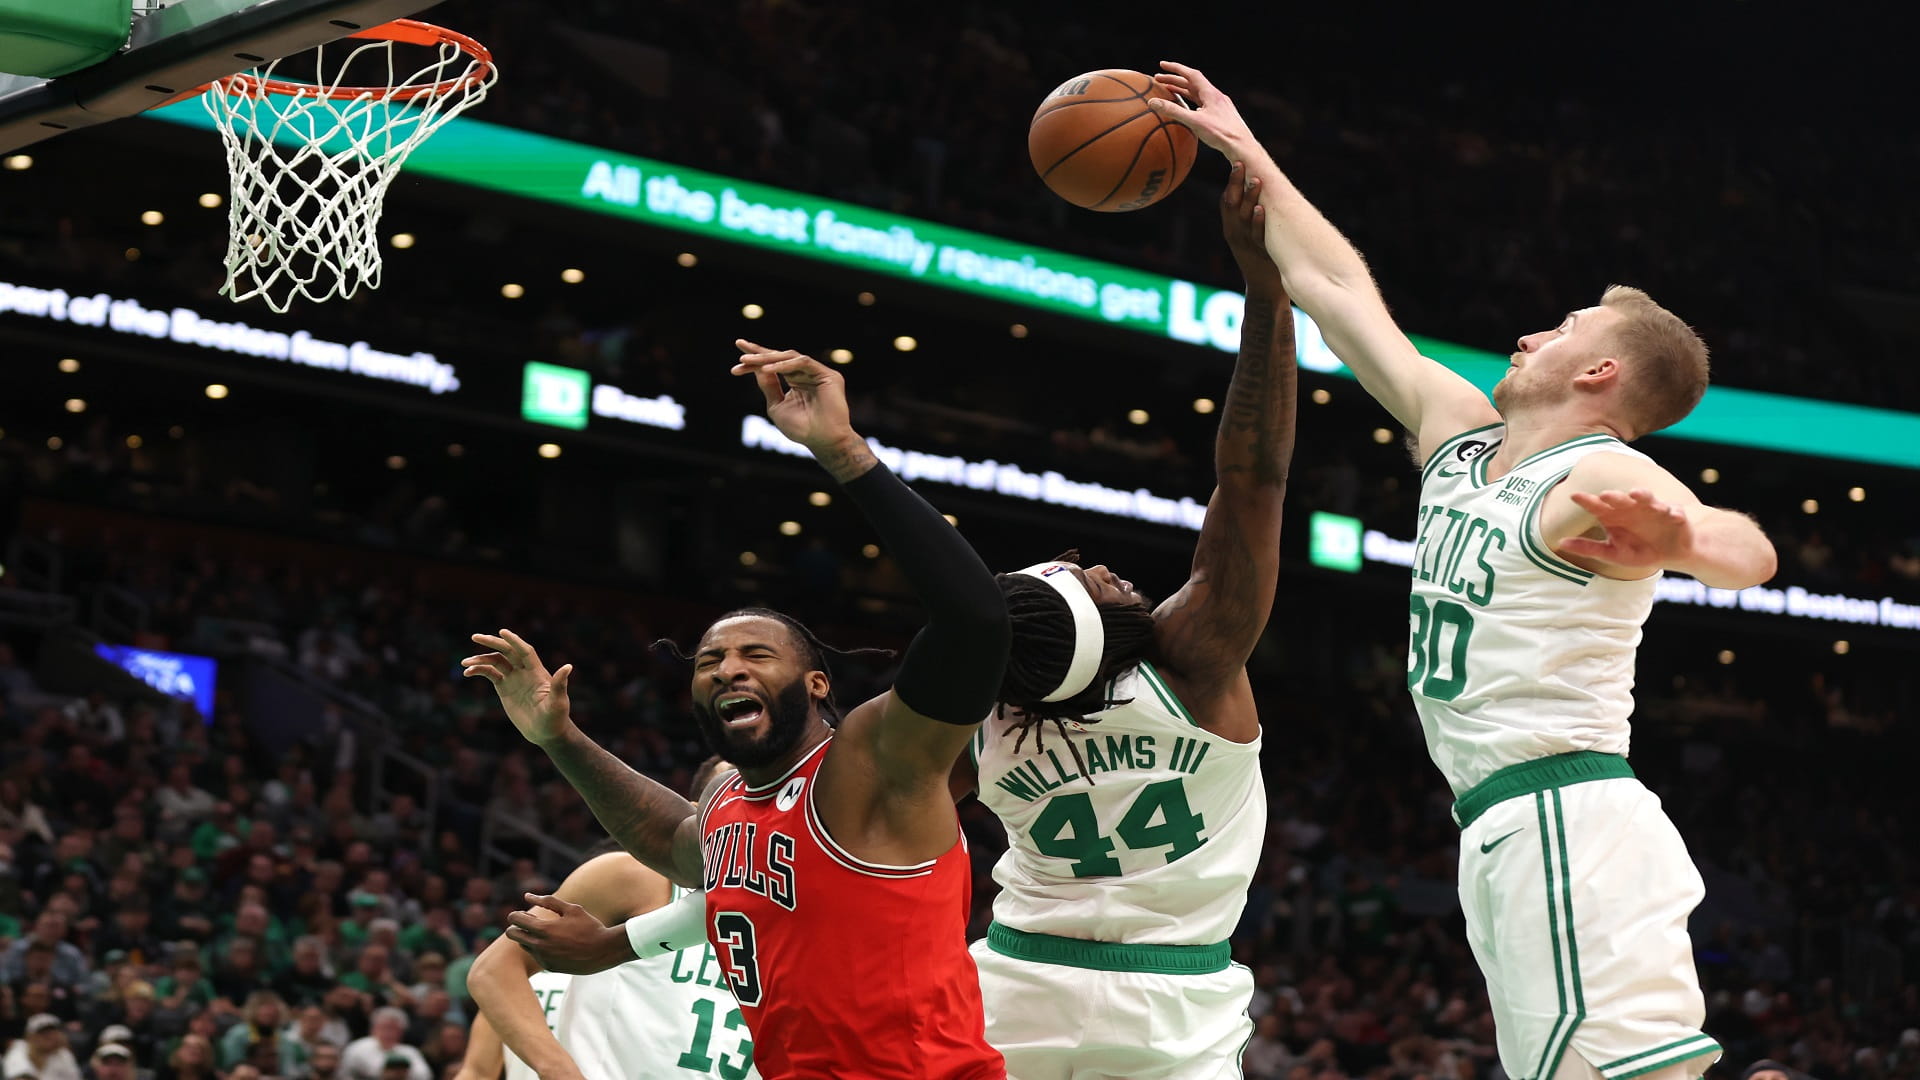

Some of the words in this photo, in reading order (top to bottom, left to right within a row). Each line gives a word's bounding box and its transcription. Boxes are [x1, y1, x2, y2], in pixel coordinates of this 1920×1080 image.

[581, 160, 642, 207] All
[646, 174, 716, 223] the
[719, 188, 810, 243] best
[814, 209, 936, 276] family
[938, 246, 1097, 308] reunions
[1100, 283, 1162, 323] get
[68, 293, 111, 327] of
[110, 299, 169, 338] the
[171, 307, 290, 361] Boston
[290, 330, 349, 372] fan
[592, 384, 686, 430] Bank
[997, 463, 1041, 500] the
[1041, 471, 1134, 518] Boston
[1495, 489, 1528, 506] PRINT
[1787, 586, 1878, 624] Boston
[1408, 592, 1474, 702] 30
[1168, 736, 1211, 775] III
[1028, 777, 1209, 879] 44
[714, 911, 763, 1008] 3
[677, 998, 755, 1080] 13
